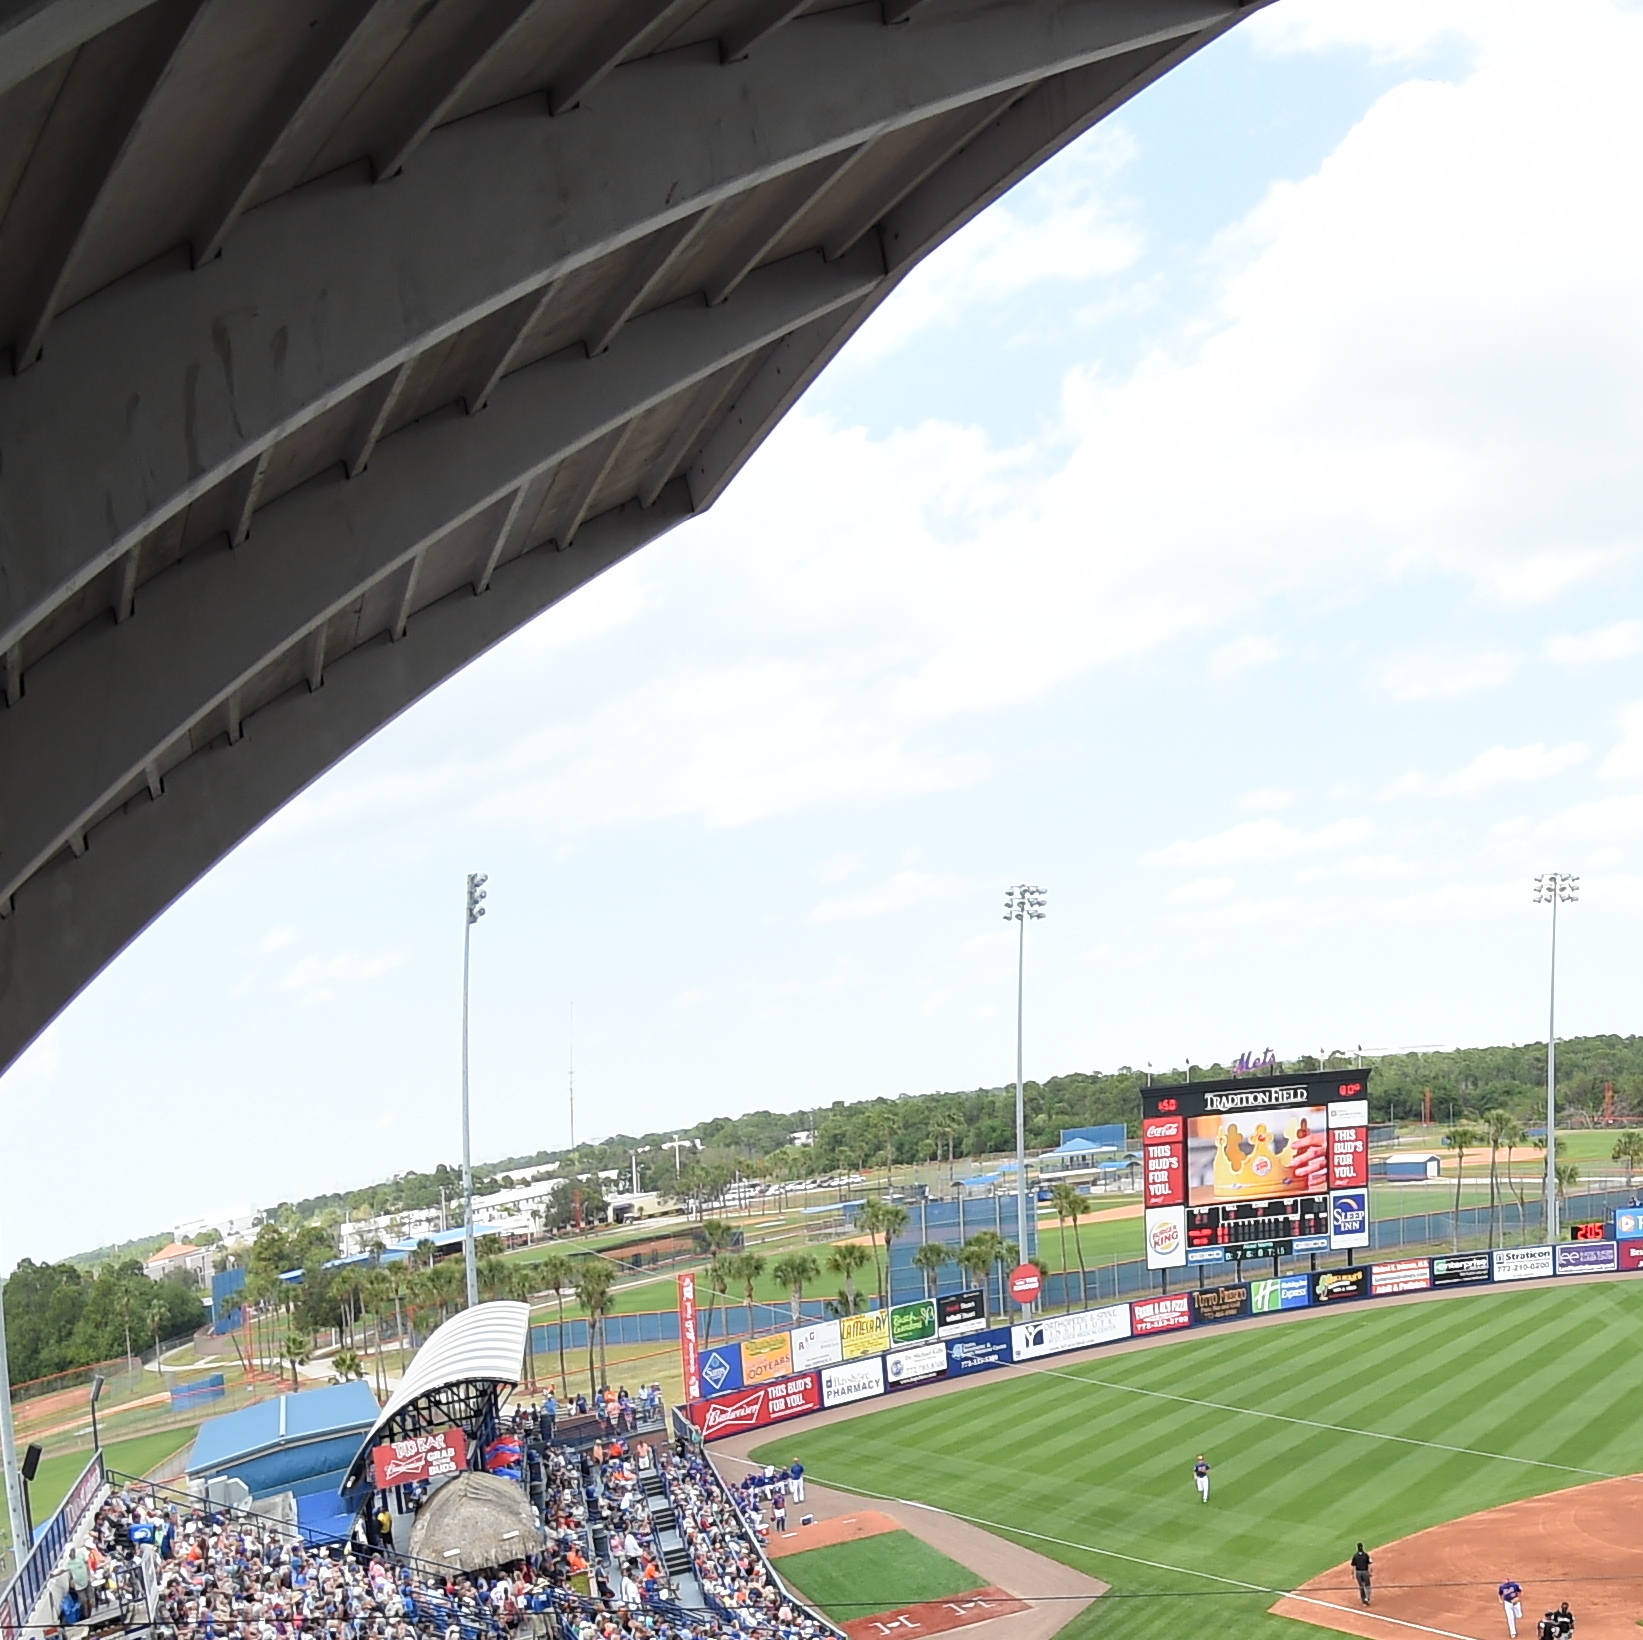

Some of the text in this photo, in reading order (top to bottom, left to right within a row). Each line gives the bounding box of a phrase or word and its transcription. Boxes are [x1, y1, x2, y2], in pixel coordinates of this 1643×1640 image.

[1232, 1047, 1276, 1075] Mets
[1205, 1084, 1307, 1111] TRADITION FIELD
[1334, 1129, 1356, 1141] THIS
[1148, 1145, 1171, 1158] THIS
[1334, 1141, 1363, 1153] BUD'S
[1148, 1157, 1178, 1170] BUD'S
[1334, 1154, 1353, 1165] FOR
[1148, 1171, 1168, 1183] FOR
[1334, 1209, 1364, 1225] SLEEP
[1341, 1222, 1360, 1231] INN
[1153, 1231, 1178, 1250] KING
[1506, 1251, 1550, 1260] Straticon
[1281, 1288, 1306, 1299] Express
[768, 1377, 812, 1399] THIS BUD'S
[827, 1377, 881, 1399] PHARMACY
[768, 1398, 787, 1413] FOR
[708, 1403, 757, 1426] Budweiser
